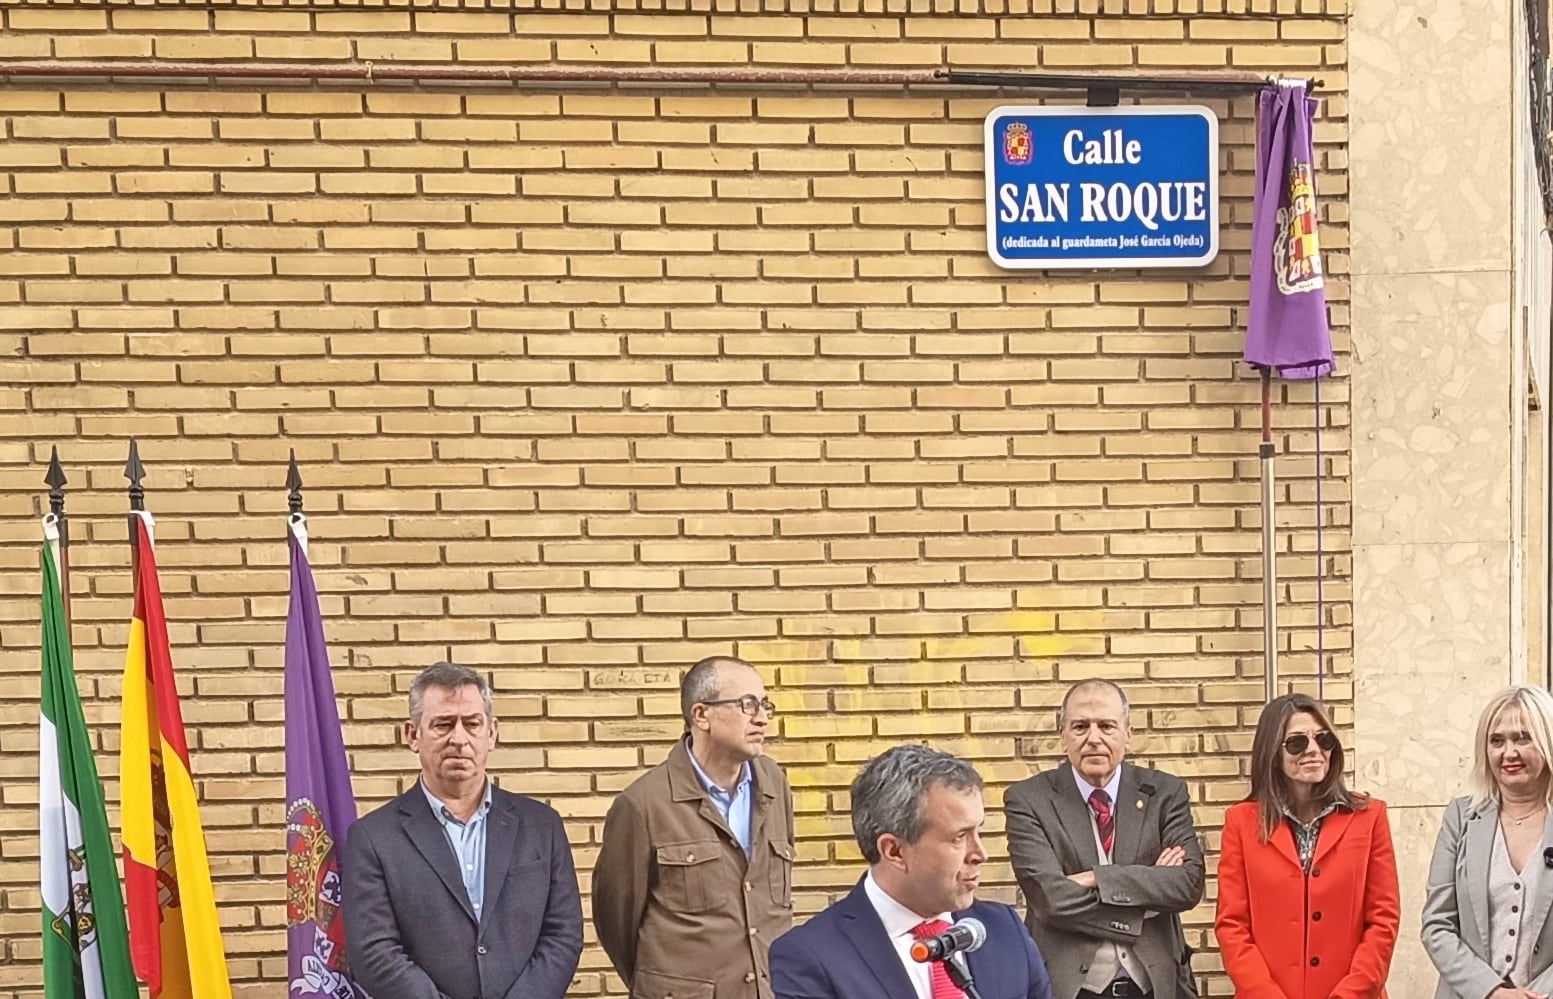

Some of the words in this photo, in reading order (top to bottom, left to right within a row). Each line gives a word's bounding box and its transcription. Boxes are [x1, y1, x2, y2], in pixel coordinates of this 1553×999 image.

[1063, 129, 1142, 165] Calle
[1000, 183, 1070, 223] SAN
[1080, 182, 1206, 231] ROQUE
[1002, 235, 1049, 250] (dedicada
[1051, 235, 1060, 248] al
[1062, 235, 1118, 250] guardameta
[1118, 234, 1139, 250] José
[1173, 234, 1205, 249] Ojeda)
